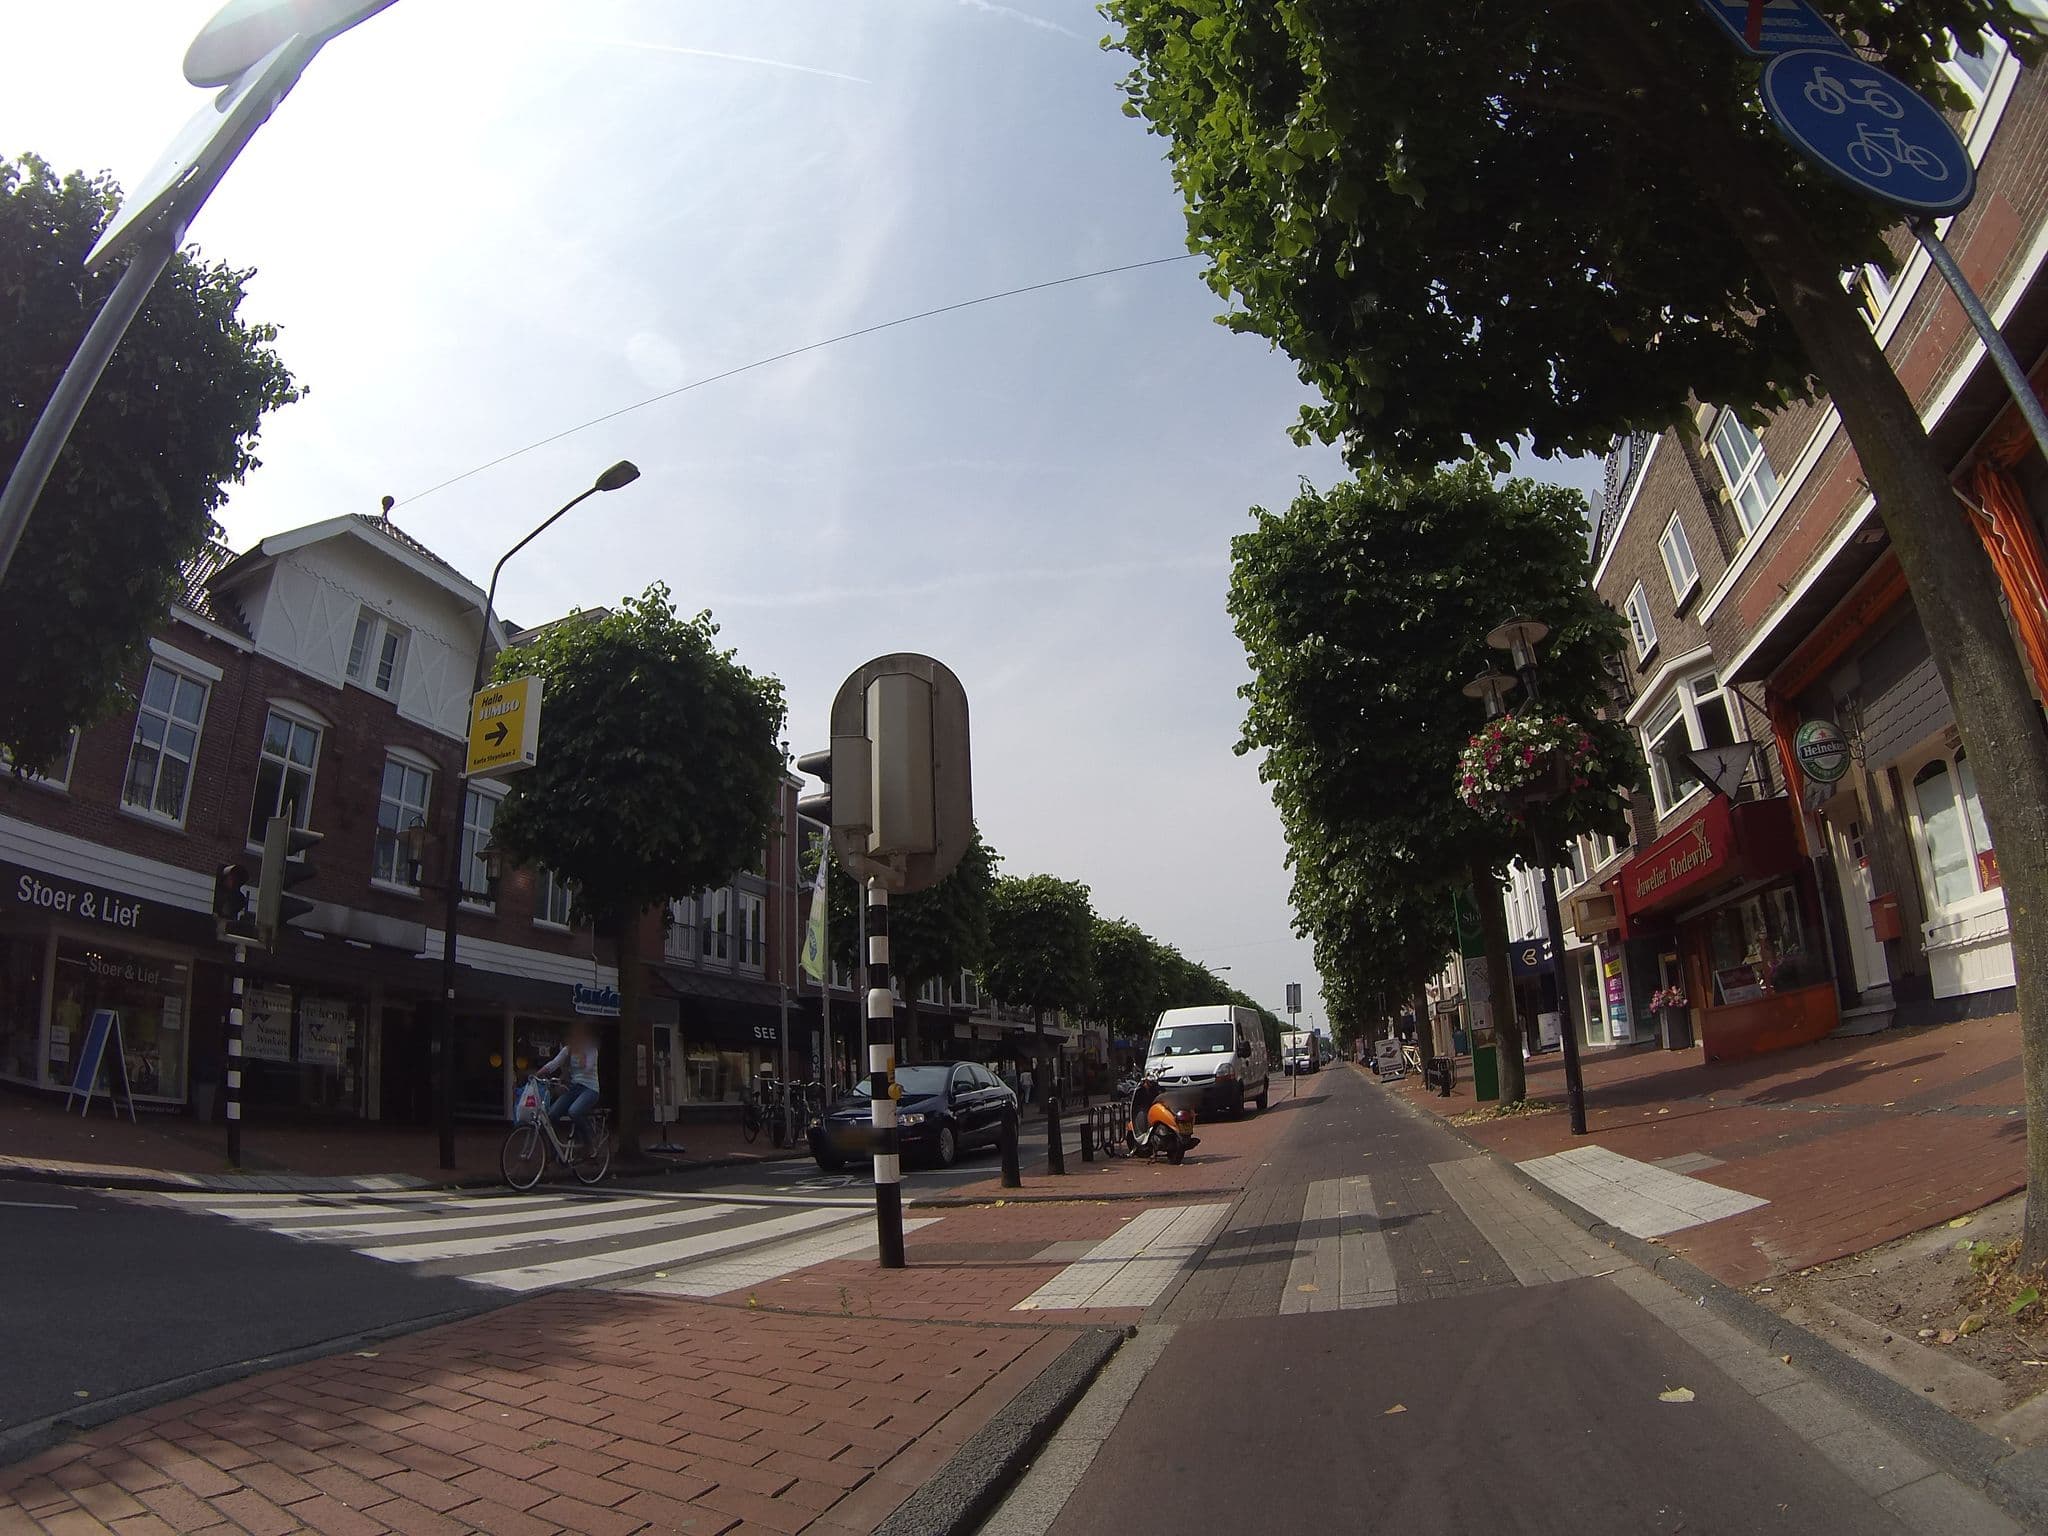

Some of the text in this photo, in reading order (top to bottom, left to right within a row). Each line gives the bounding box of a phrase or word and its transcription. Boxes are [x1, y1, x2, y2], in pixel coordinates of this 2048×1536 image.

[481, 692, 503, 708] Hallo
[1636, 836, 1713, 898] Juwelier Rodewijk
[17, 874, 142, 928] Stoer & Lief
[88, 958, 160, 985] Stoer & Lief
[753, 1026, 777, 1040] SEE
